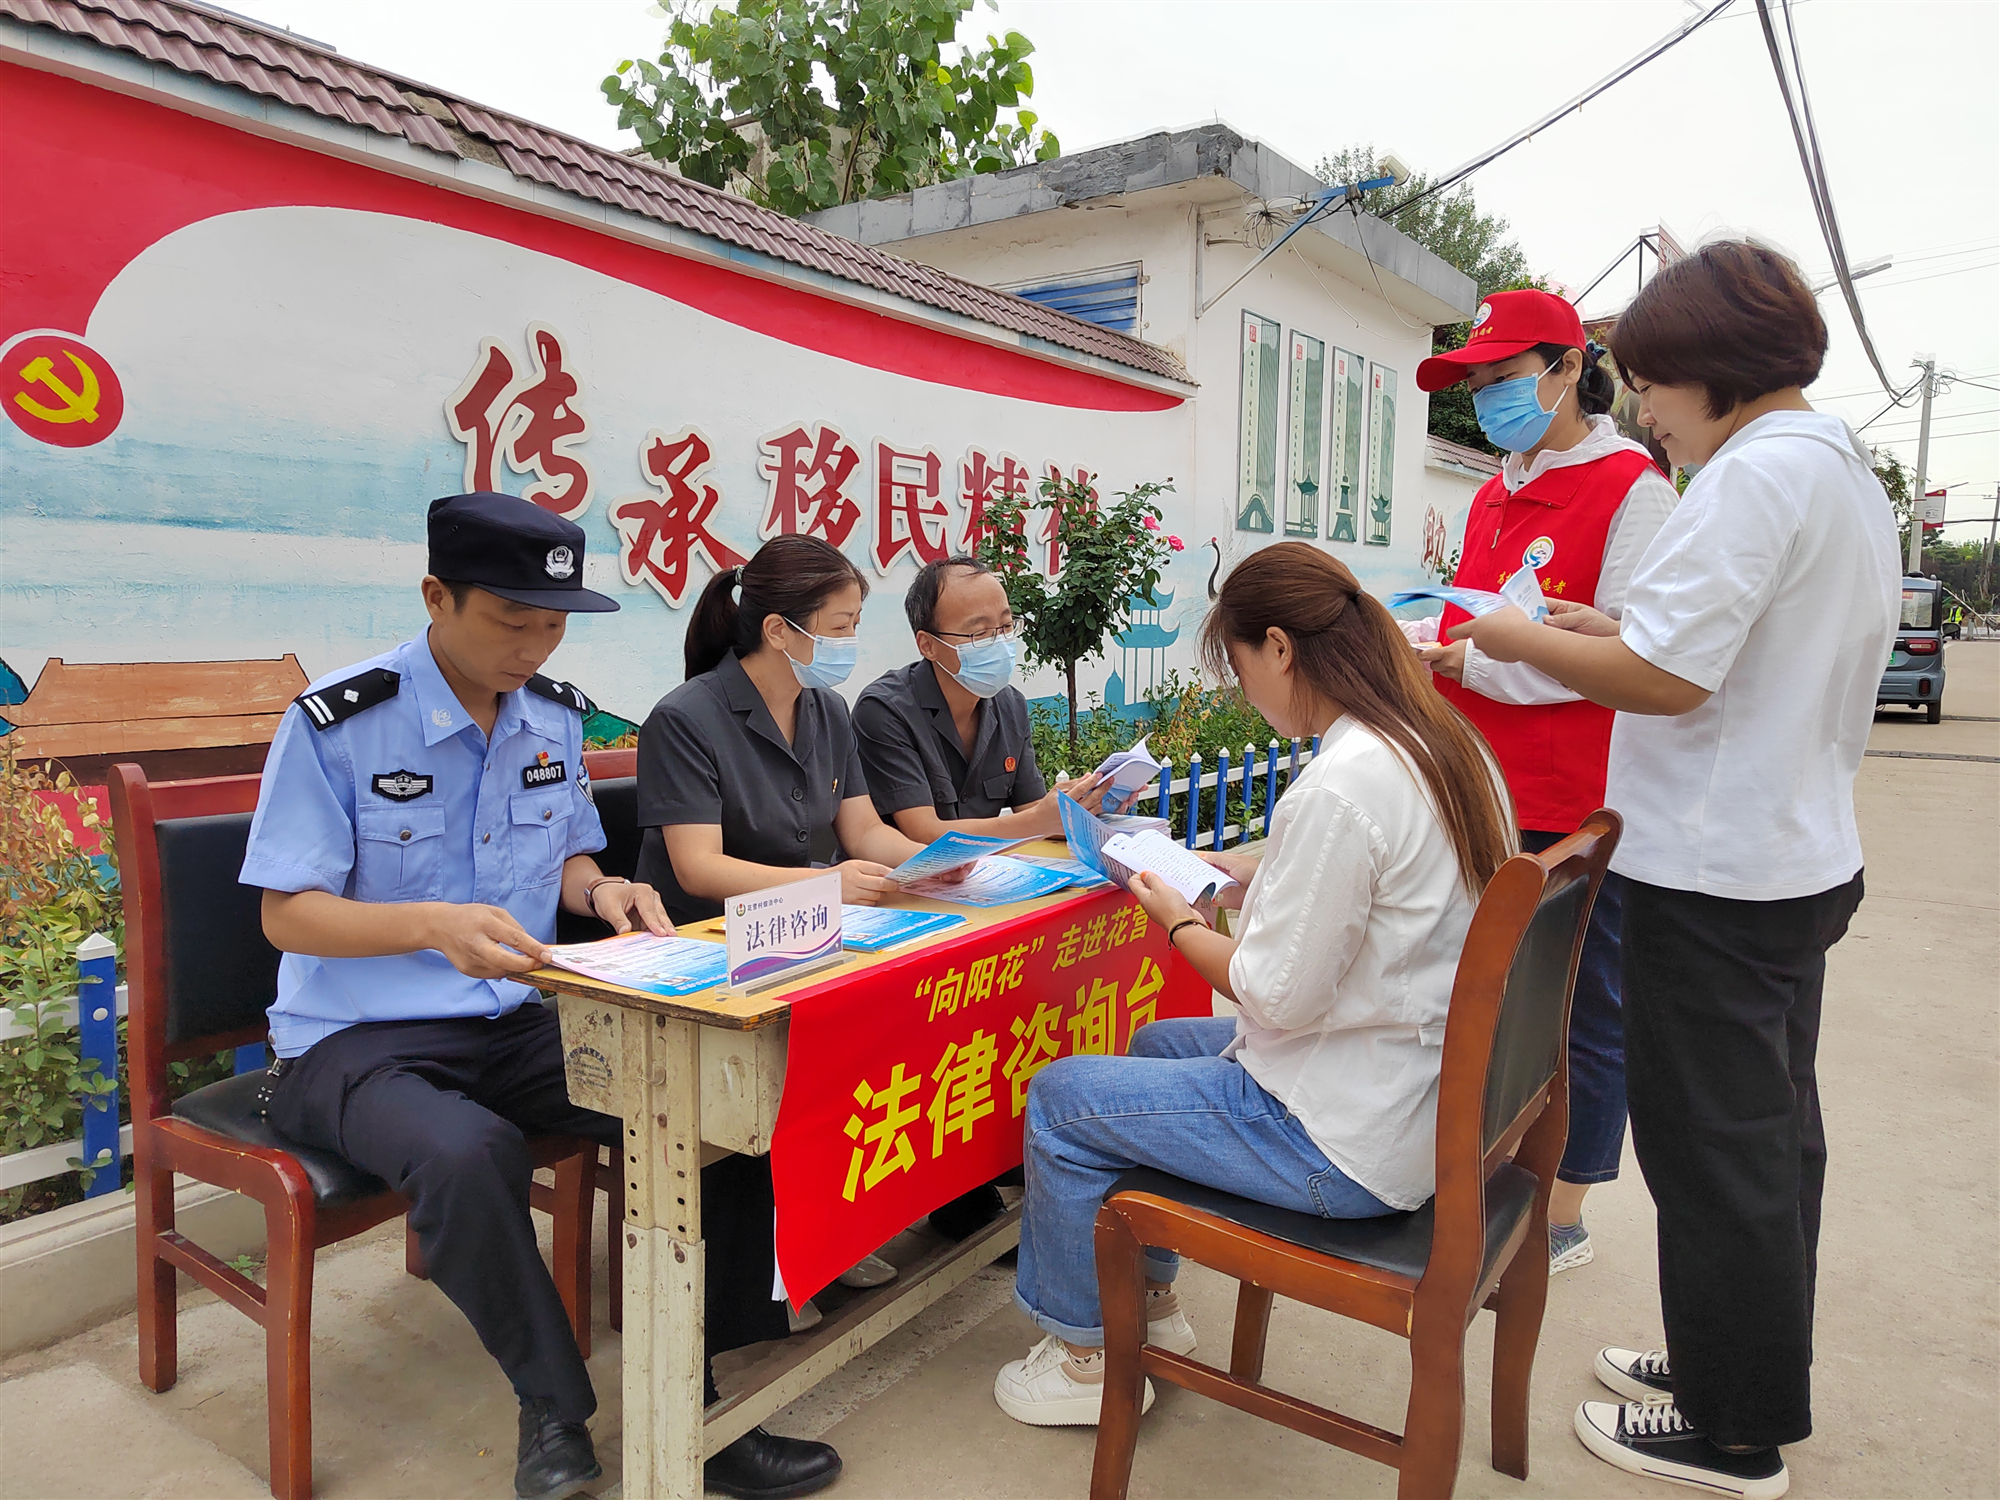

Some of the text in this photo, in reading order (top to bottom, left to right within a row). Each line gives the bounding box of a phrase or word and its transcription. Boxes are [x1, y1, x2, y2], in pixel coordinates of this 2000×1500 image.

[526, 764, 562, 784] 048807
[746, 904, 828, 952] 法律咨询
[842, 956, 1166, 1203] 法律咨询台
